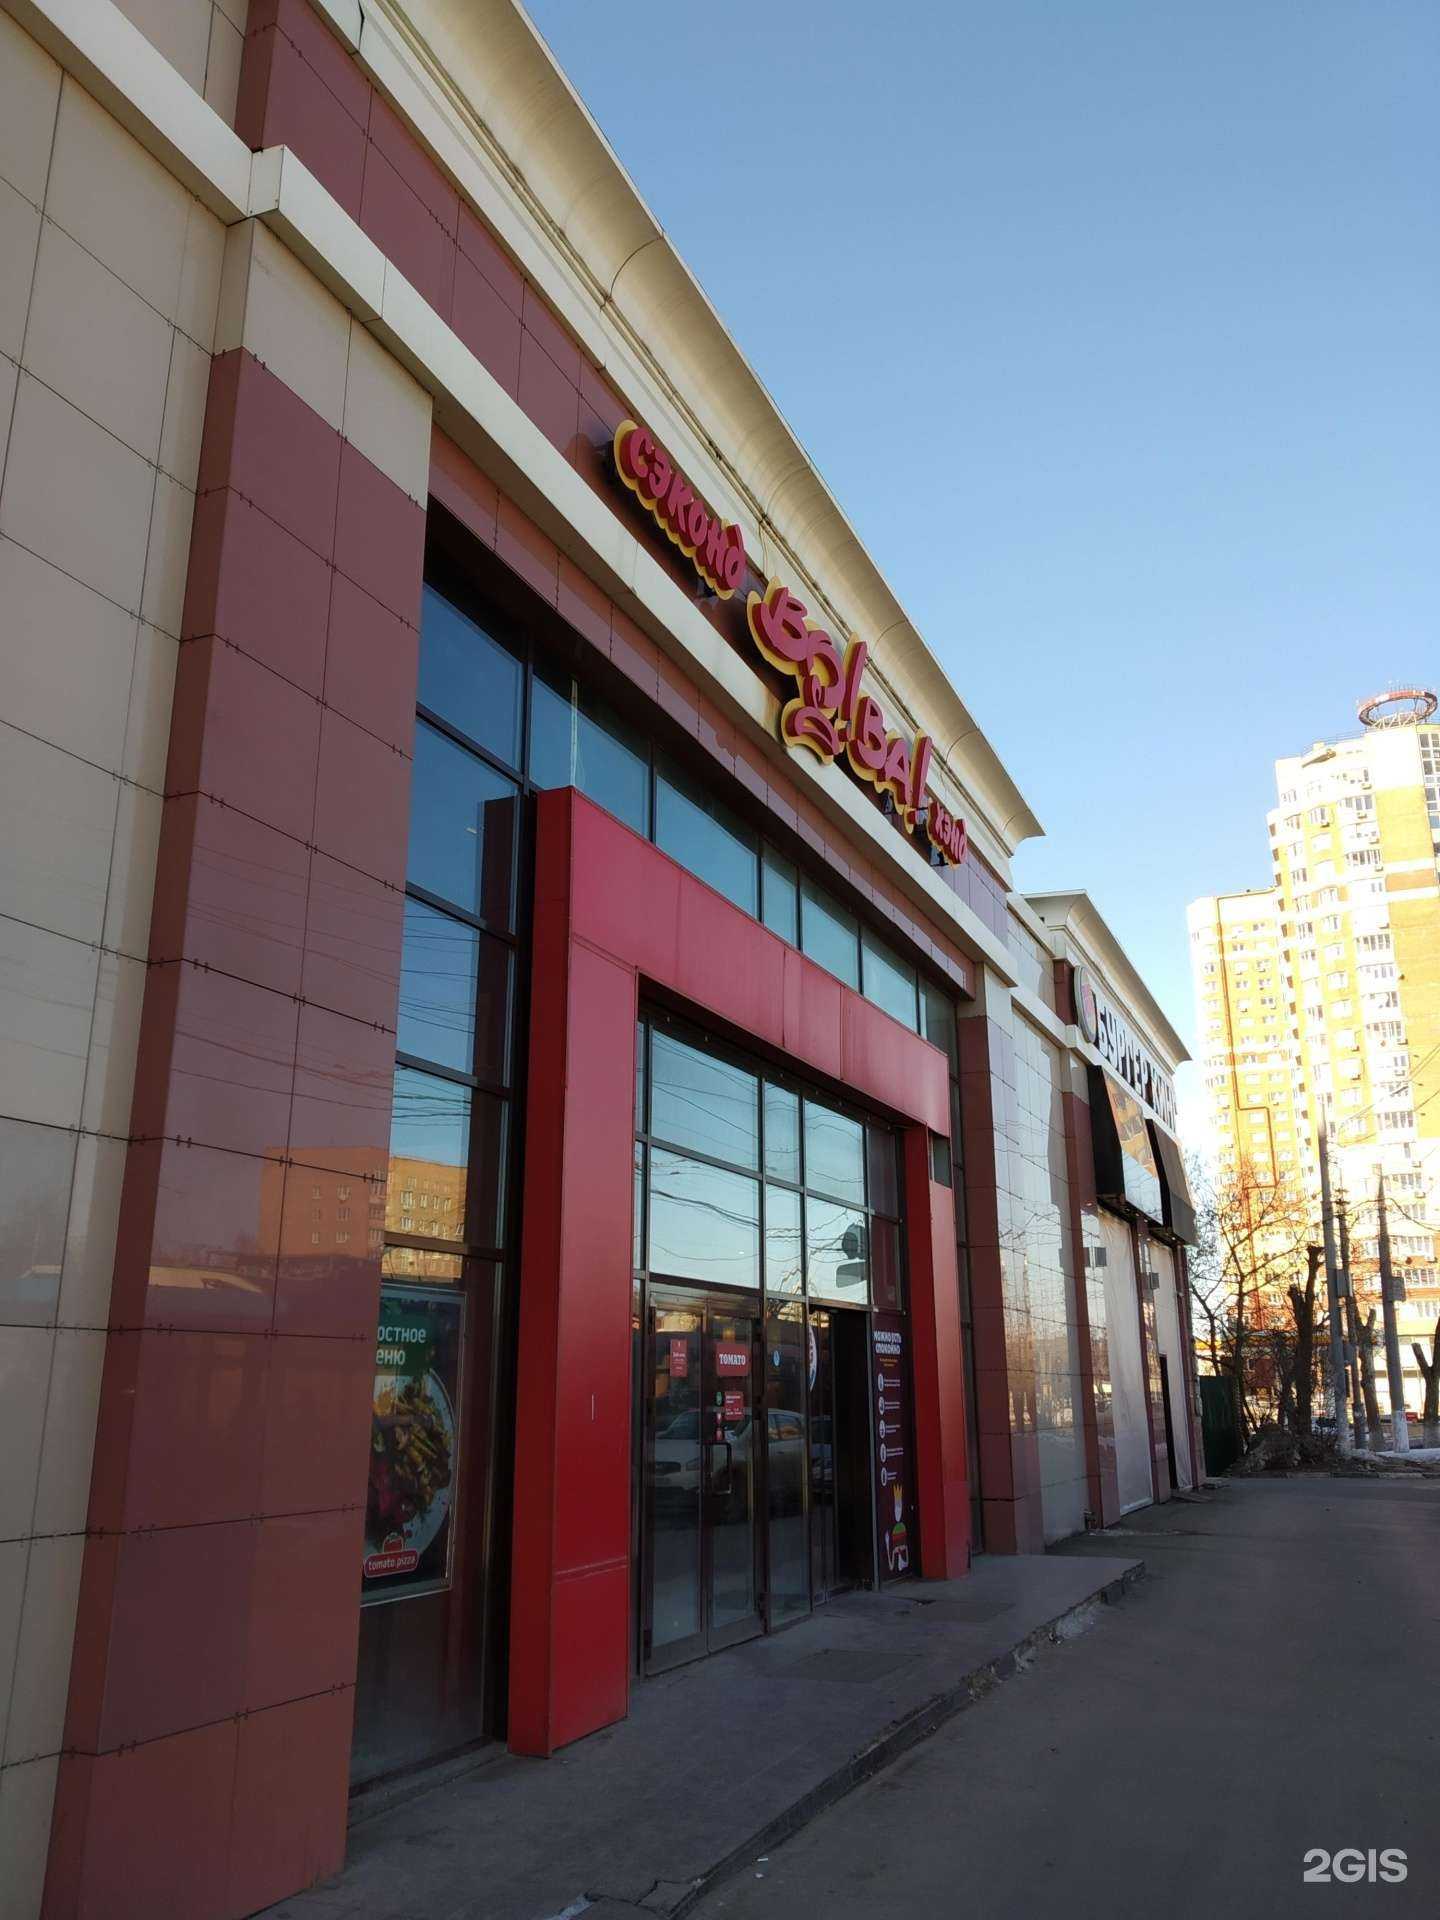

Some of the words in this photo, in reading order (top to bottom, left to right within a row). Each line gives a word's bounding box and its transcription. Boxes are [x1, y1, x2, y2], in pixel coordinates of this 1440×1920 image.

[1098, 1004, 1149, 1100] БУРГЕР
[376, 1326, 426, 1343] остное
[375, 1349, 405, 1365] еню
[719, 1353, 746, 1366] TOMATO
[368, 1558, 395, 1571] tomato
[396, 1555, 416, 1569] pizza
